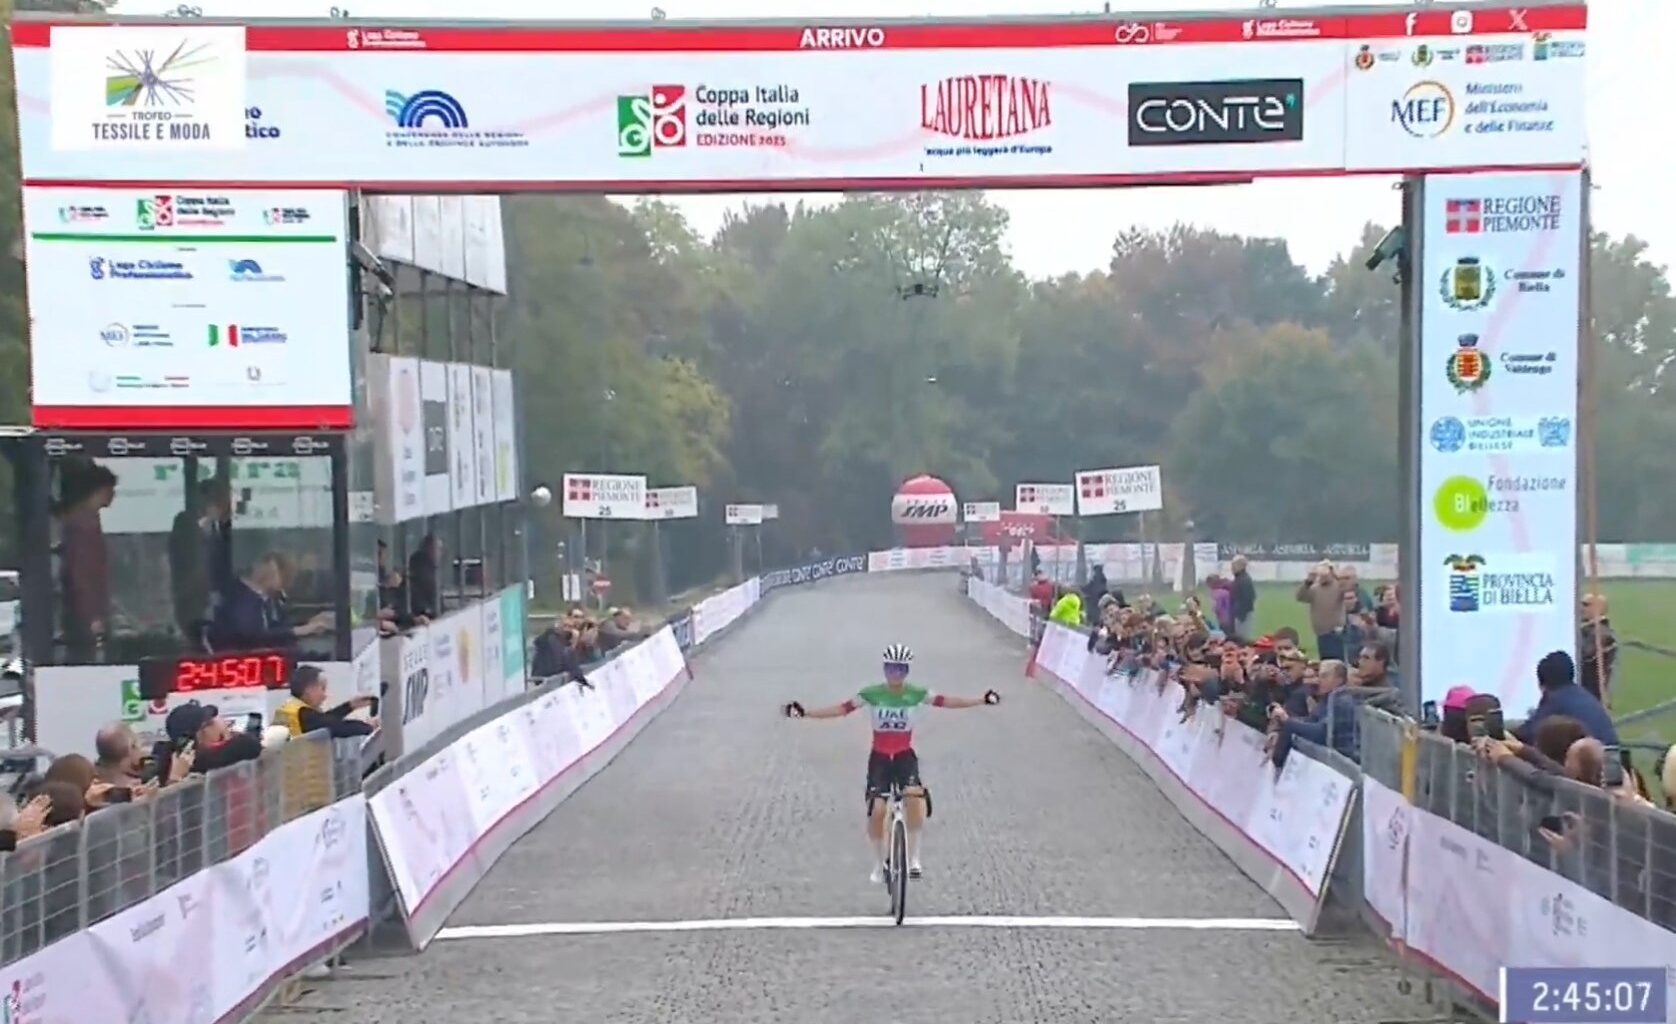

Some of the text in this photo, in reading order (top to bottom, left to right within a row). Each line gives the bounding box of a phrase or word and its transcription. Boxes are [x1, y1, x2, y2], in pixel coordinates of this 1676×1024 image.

[800, 27, 885, 48] ARRIVO
[696, 84, 799, 107] Coppa Italia
[920, 74, 1052, 140] LAURETANA
[1391, 97, 1447, 123] MEF
[696, 108, 809, 129] delle Regioni
[696, 133, 755, 147] EDIZIONE
[1483, 196, 1561, 214] REGIONE
[1483, 214, 1560, 232] PIEMONTE
[1487, 475, 1567, 492] Fondazione
[599, 506, 612, 516] 25
[1114, 500, 1127, 512] 25
[1483, 573, 1553, 589] PROVINCIA
[1483, 589, 1553, 606] DI BIELLA
[177, 655, 284, 691] 2:45:07
